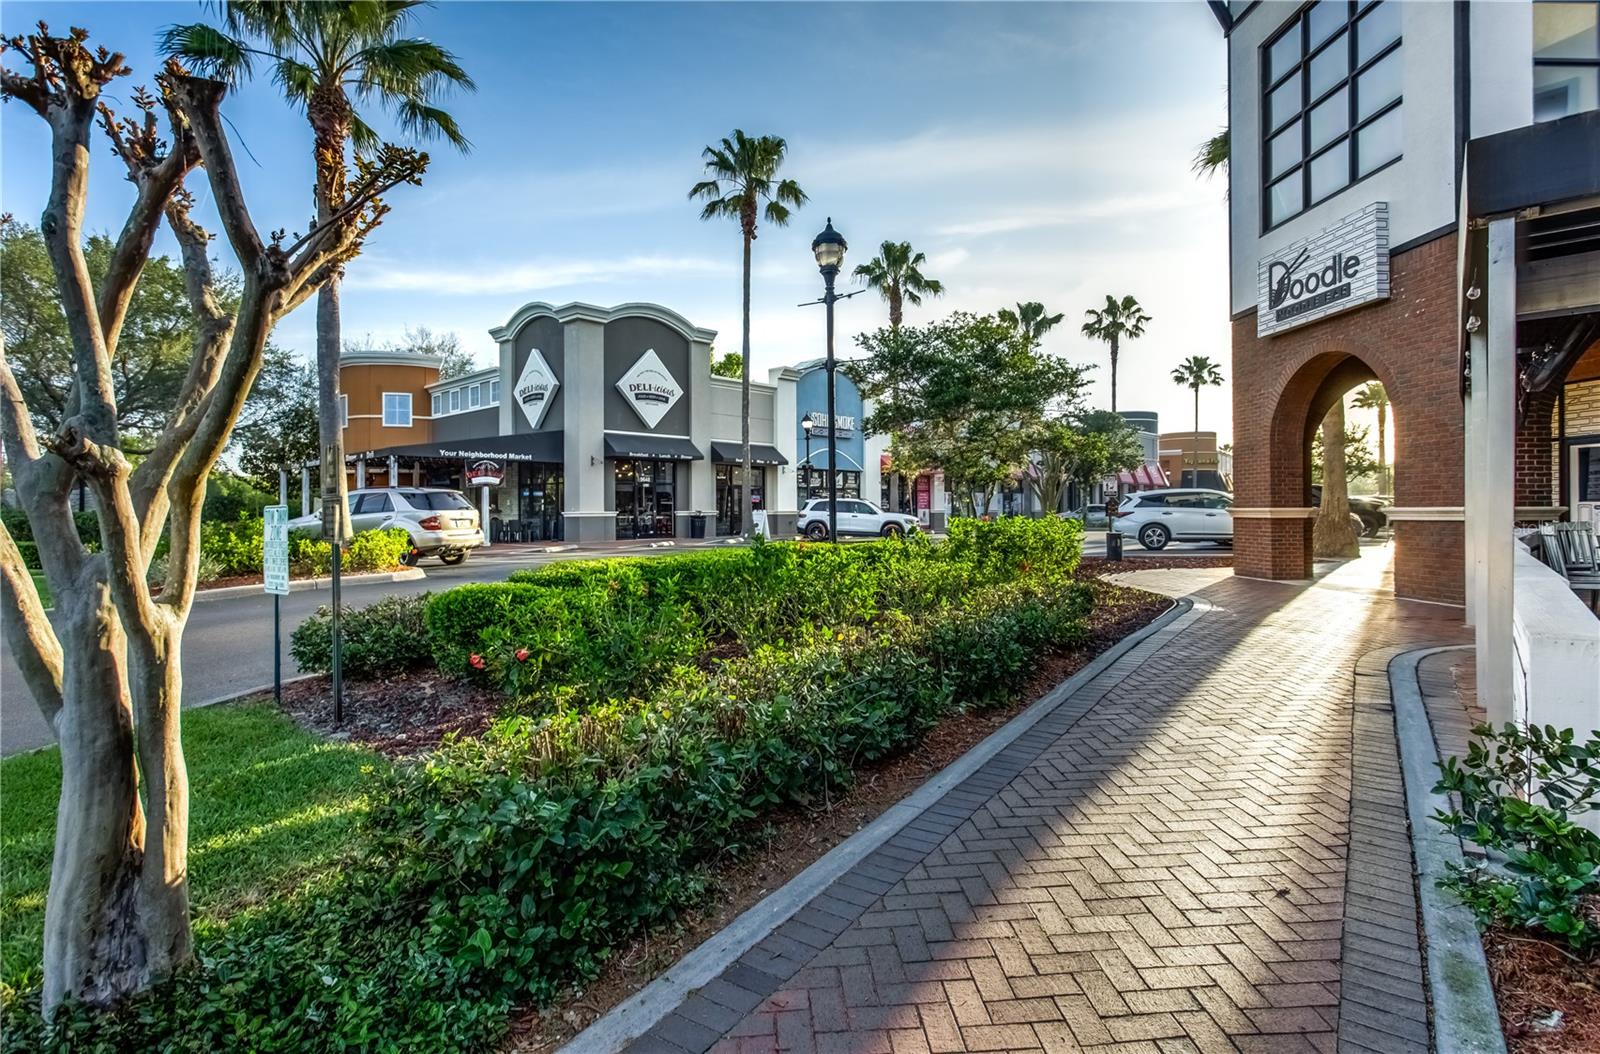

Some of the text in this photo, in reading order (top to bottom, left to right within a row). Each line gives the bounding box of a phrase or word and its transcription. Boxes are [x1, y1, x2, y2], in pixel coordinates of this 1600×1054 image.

[1268, 250, 1361, 310] Doodle
[811, 411, 829, 427] SOH
[439, 449, 457, 457] Your
[458, 450, 507, 459] Neighborhood
